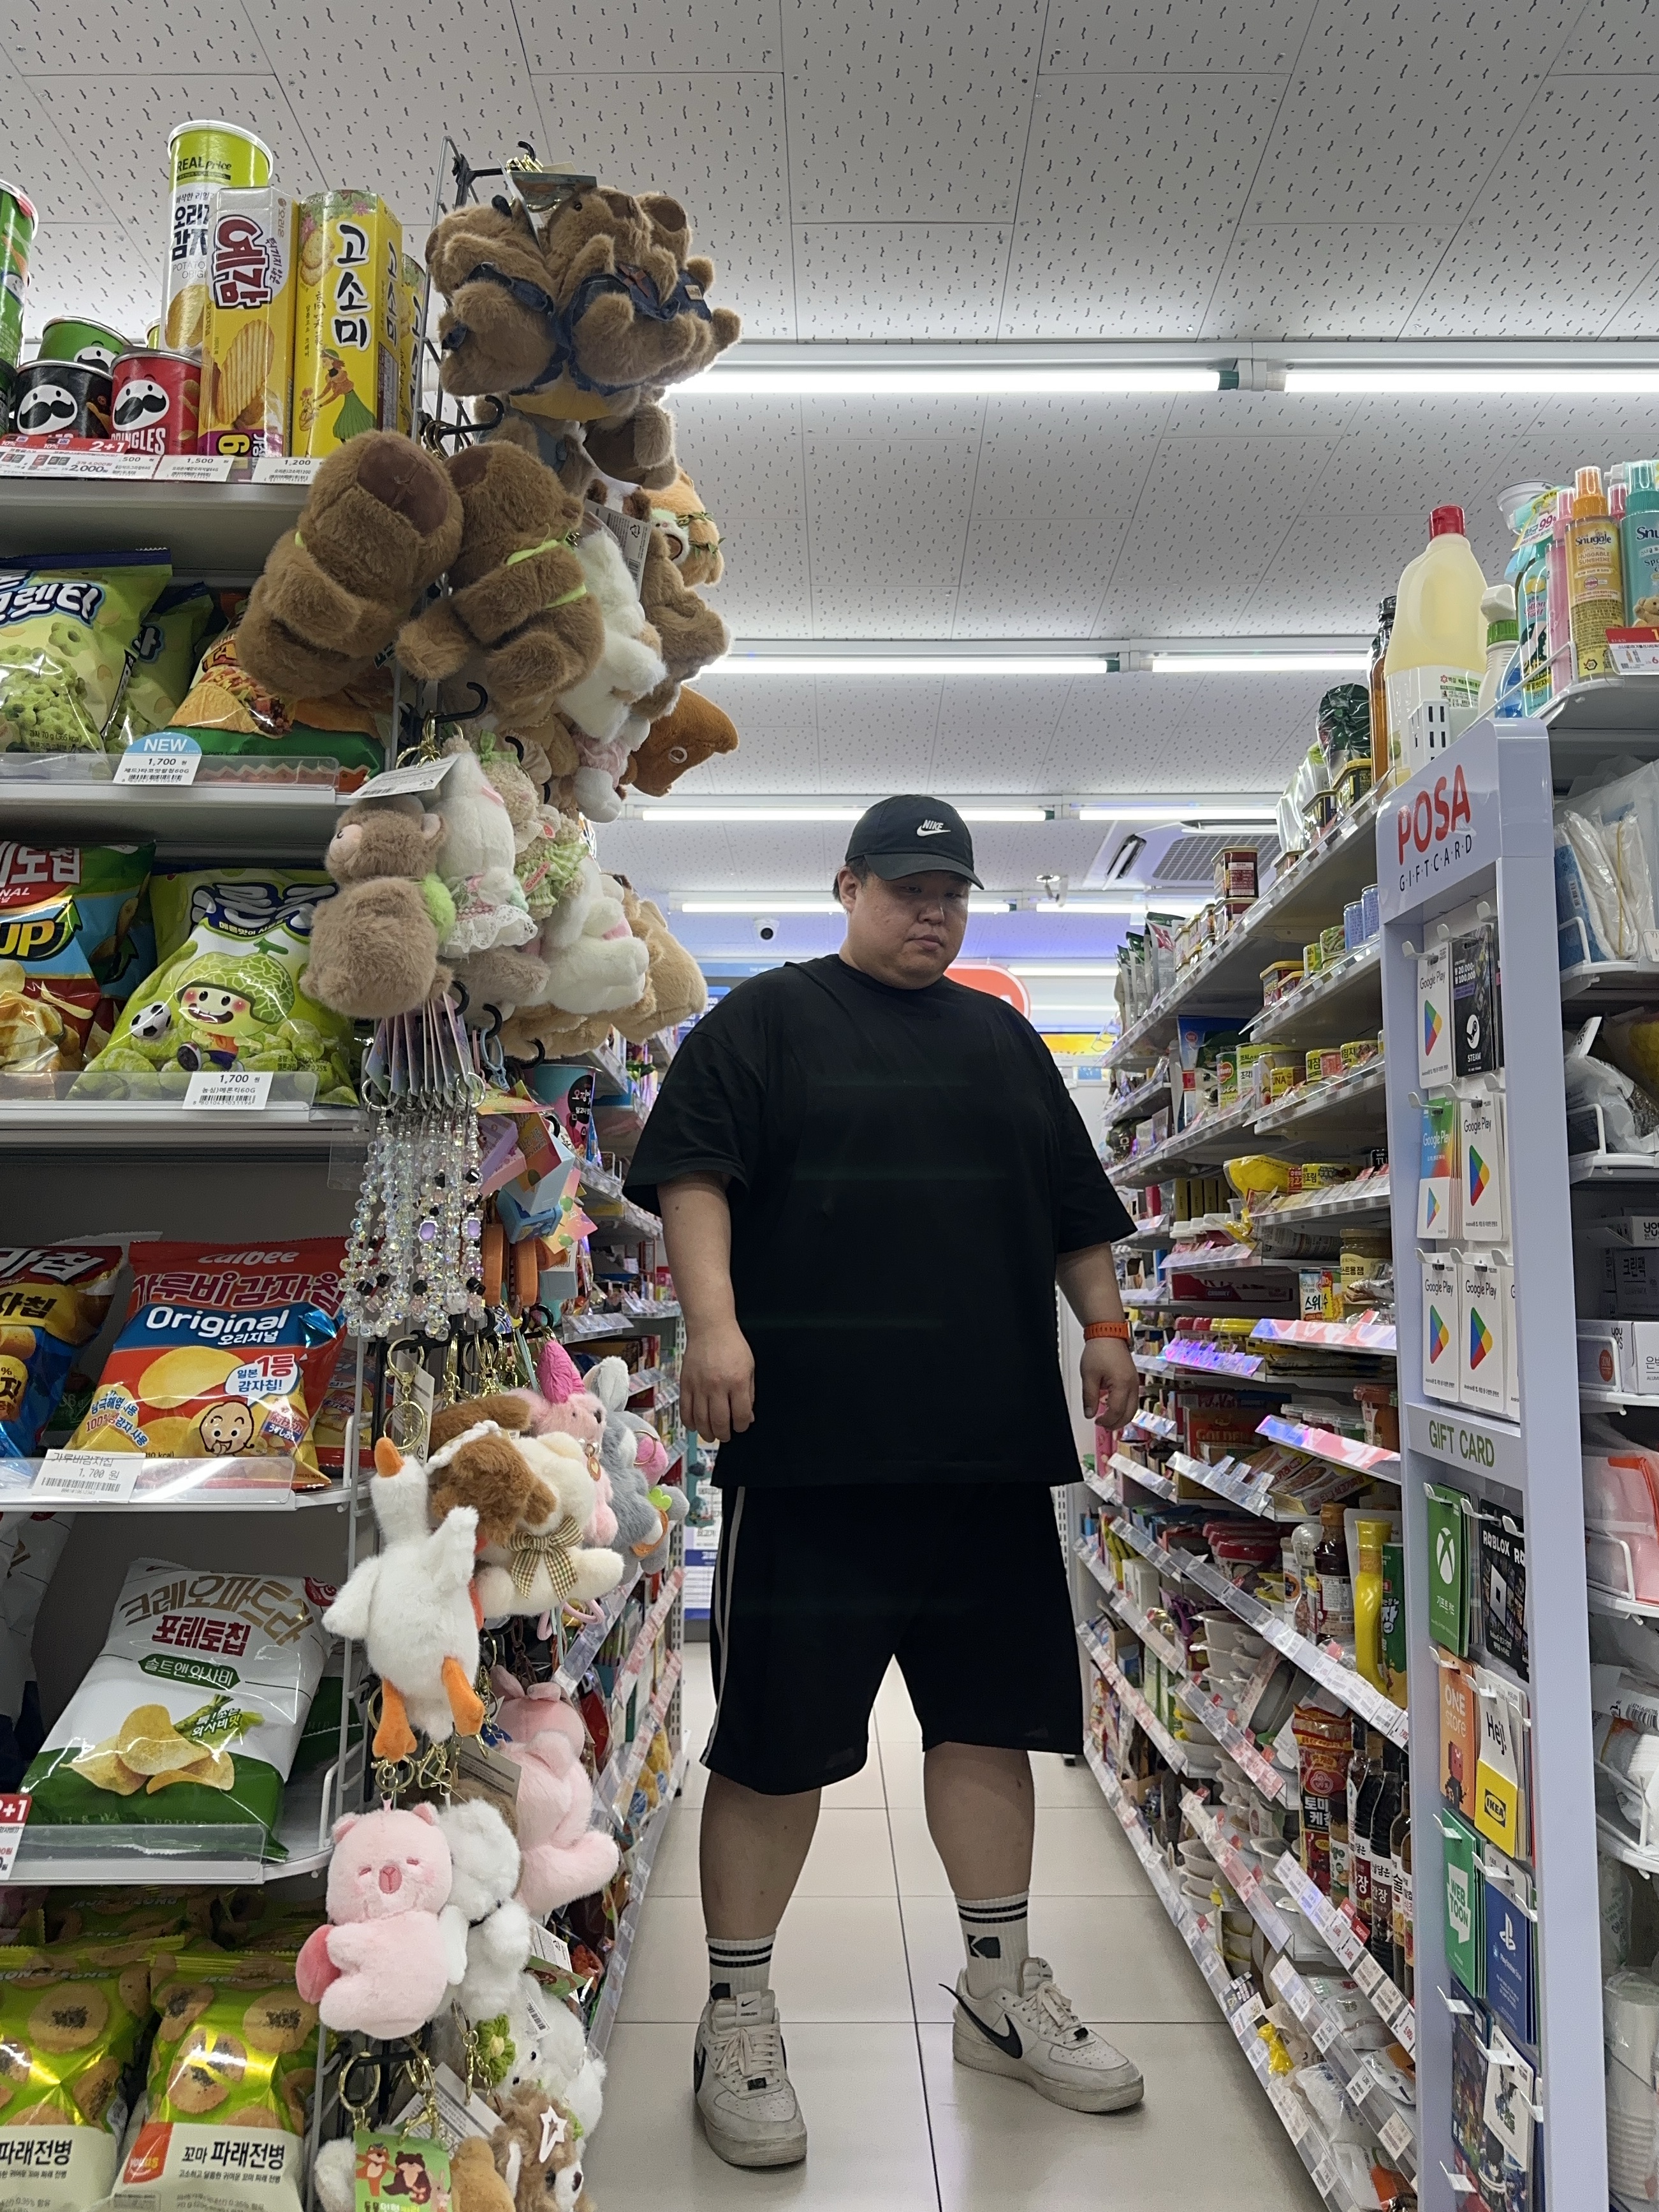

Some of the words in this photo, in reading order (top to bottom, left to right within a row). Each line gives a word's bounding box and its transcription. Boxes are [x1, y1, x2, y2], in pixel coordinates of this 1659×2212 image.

[177, 157, 204, 173] REAL
[172, 261, 205, 272] POTATO
[214, 217, 272, 306] 예감
[335, 224, 368, 348] 고소미
[386, 242, 397, 347] 고소미
[89, 441, 126, 453] 2+1
[1575, 530, 1612, 547] Snuggle
[143, 738, 187, 752] NEW
[922, 819, 944, 831] NIKE
[1397, 764, 1471, 867] POSA
[1420, 972, 1436, 990] Google
[1436, 969, 1446, 984] Play
[1467, 1052, 1482, 1063] STEAM
[220, 1075, 249, 1083] 1,700
[1464, 1118, 1481, 1134] Google
[1481, 1117, 1491, 1132] Play
[1423, 1132, 1440, 1148] Google
[1440, 1130, 1451, 1146] Play
[231, 1272, 347, 1319] 감자칩
[1425, 1279, 1442, 1296] Google
[1442, 1280, 1454, 1296] Play
[1465, 1279, 1485, 1300] Google
[1486, 1282, 1497, 1300] Play
[146, 1307, 289, 1338] Original
[217, 1331, 279, 1345] 오리지널
[237, 1369, 258, 1379] 일본
[256, 1354, 294, 1377] 1등
[238, 1379, 282, 1392] 감자칩!
[131, 1429, 149, 1446] 사용
[1429, 1419, 1454, 1454] GIFT
[1459, 1430, 1495, 1468] CARD
[79, 1468, 105, 1478] 1,700
[108, 1470, 120, 1481] 원
[1483, 1530, 1510, 1557] ROBLOX
[1445, 1684, 1465, 1717] ONE
[192, 1714, 241, 1737] 와사비맛
[1445, 1710, 1466, 1738] store
[1486, 1711, 1507, 1755] Hej!
[1487, 1795, 1504, 1818] IKEA
[1451, 1879, 1465, 1907] WEB
[1449, 1896, 1468, 1928] TOON
[0, 2139, 73, 2165] 파래전병
[182, 2146, 207, 2164] 꼬마
[211, 2141, 285, 2171] 파래전병
[269, 2175, 281, 2183] 전병
